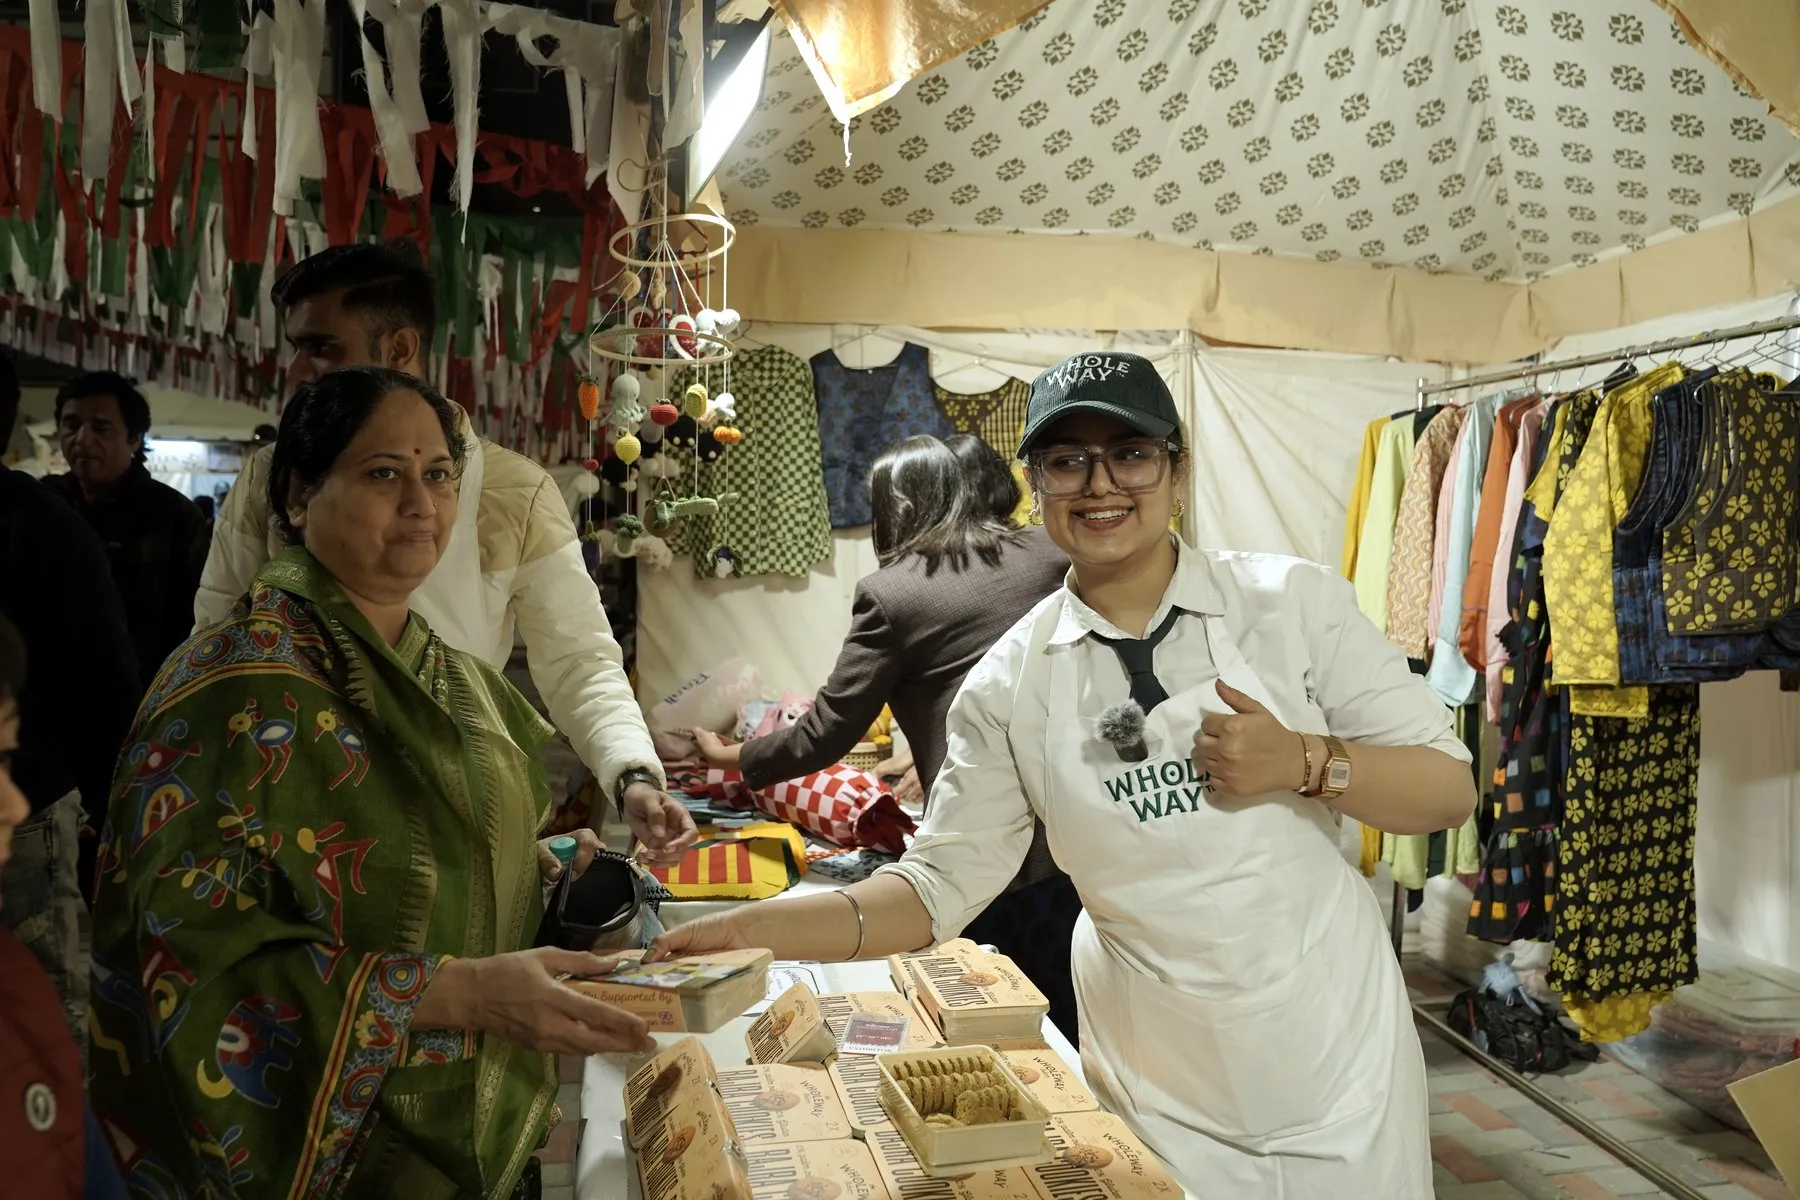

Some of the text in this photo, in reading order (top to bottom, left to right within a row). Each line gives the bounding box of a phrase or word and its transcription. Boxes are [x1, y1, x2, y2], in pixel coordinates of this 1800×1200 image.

[1046, 355, 1131, 386] WHOLE
[1058, 367, 1113, 389] WAY
[1104, 758, 1212, 802] WHOL
[1129, 786, 1200, 823] WAY
[601, 991, 657, 1004] Supported
[933, 978, 988, 1007] COOKIES
[717, 1069, 763, 1098] BAJRA
[1033, 1056, 1065, 1091] WHOLEWAY
[800, 1080, 825, 1118] WHOLEWAY
[725, 1101, 777, 1140] COOKIES
[746, 1148, 799, 1188] BAJRA
[1103, 1132, 1143, 1176] WHOLEWAY
[1153, 1181, 1171, 1193] 2X
